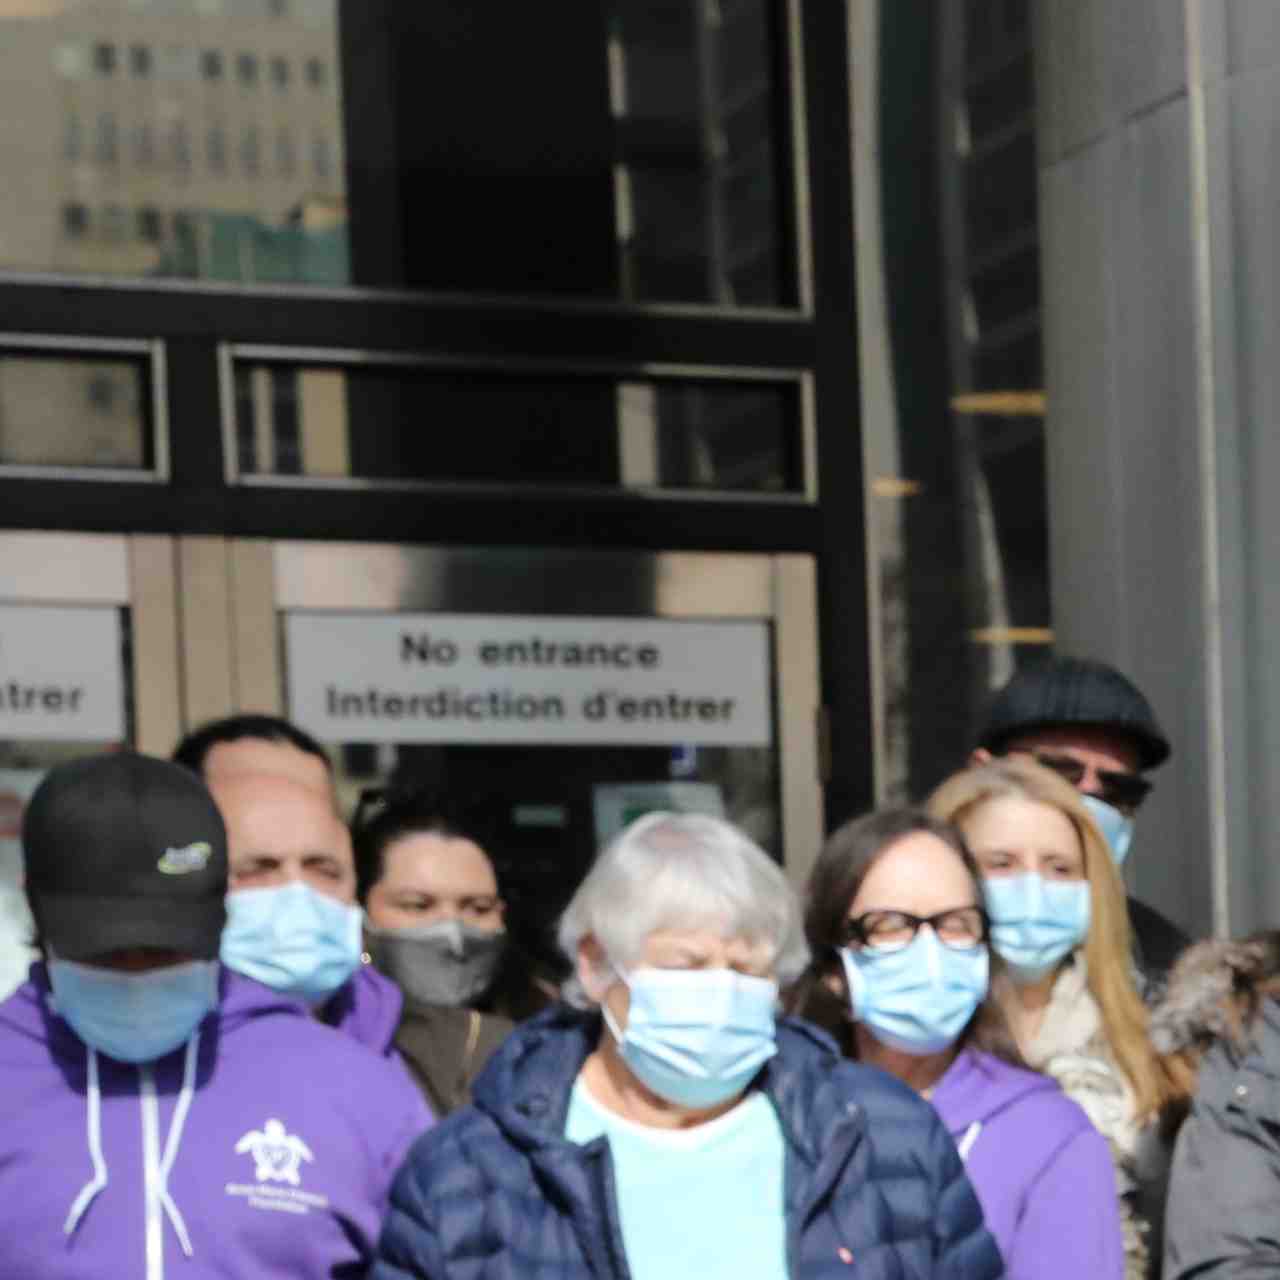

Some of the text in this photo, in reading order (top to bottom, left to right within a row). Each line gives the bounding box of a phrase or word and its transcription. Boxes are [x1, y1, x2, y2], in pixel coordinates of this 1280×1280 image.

[401, 633, 660, 669] No entrance
[0, 683, 82, 713] trer
[326, 686, 737, 722] Interdiction d'entrer
